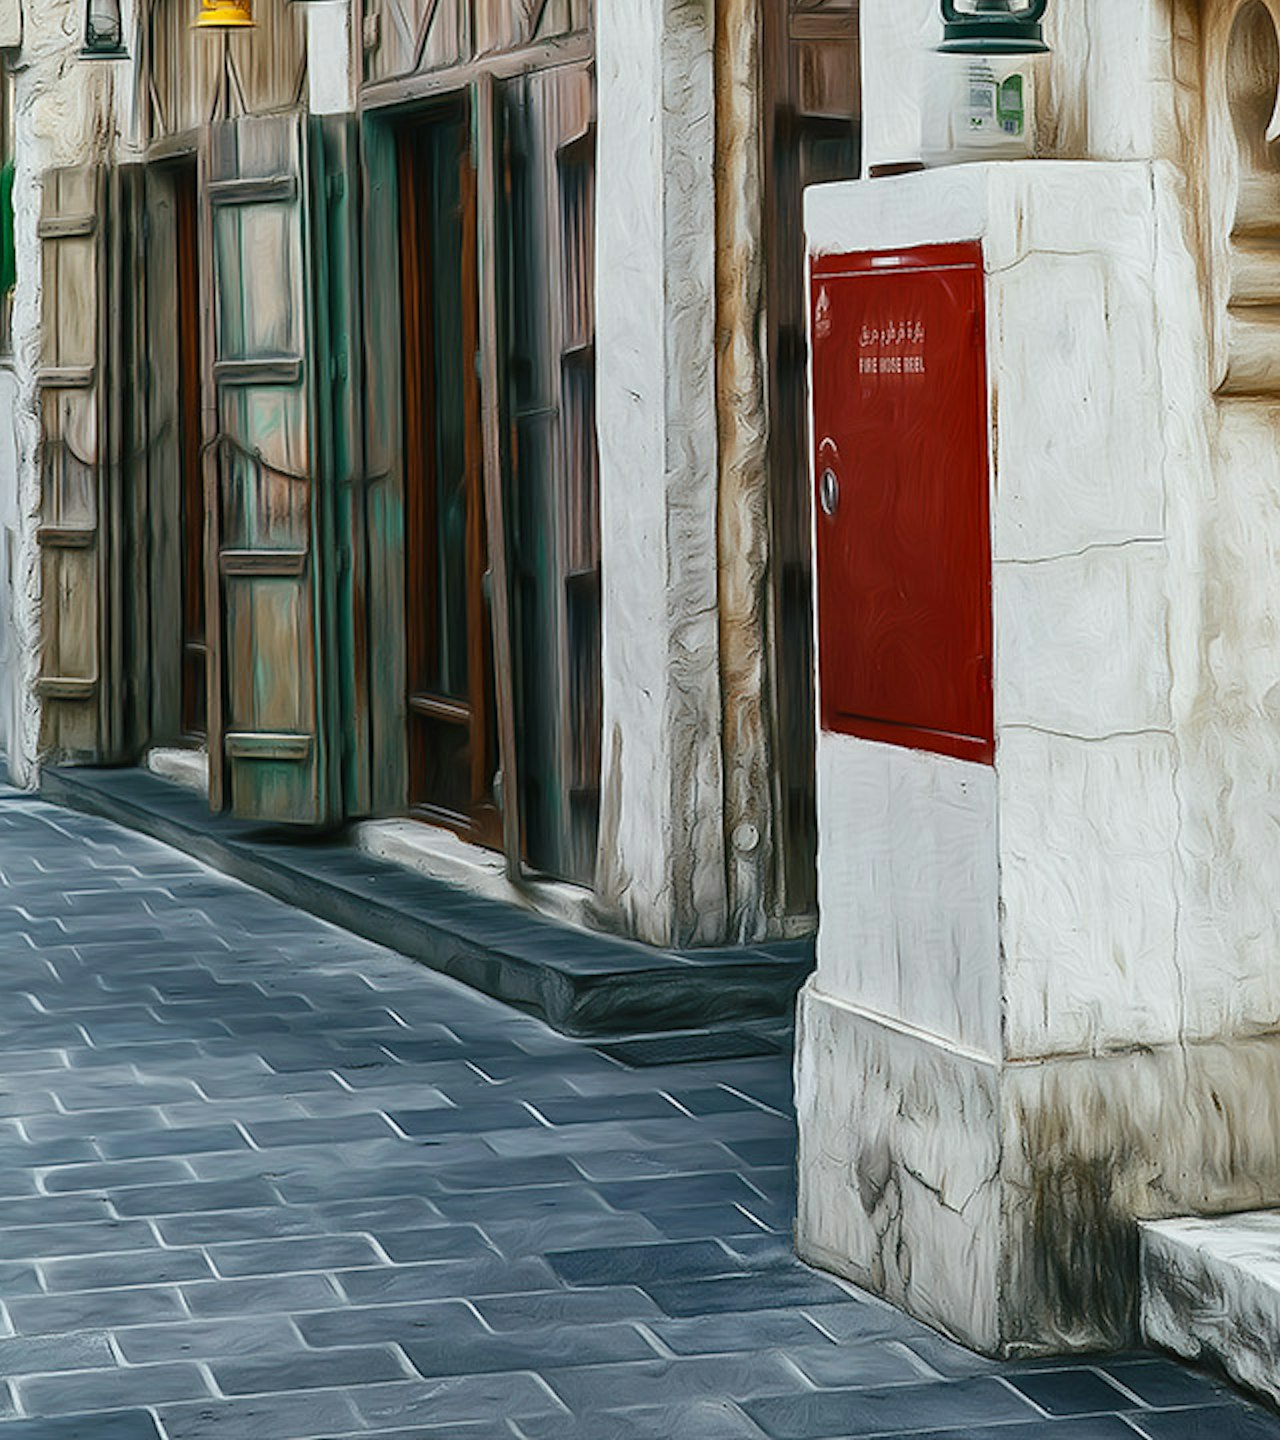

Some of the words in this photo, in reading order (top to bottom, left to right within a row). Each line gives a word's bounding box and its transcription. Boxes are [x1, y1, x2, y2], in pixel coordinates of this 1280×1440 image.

[859, 357, 878, 374] FIRE
[879, 357, 902, 374] HOSE
[902, 356, 926, 374] REEL
